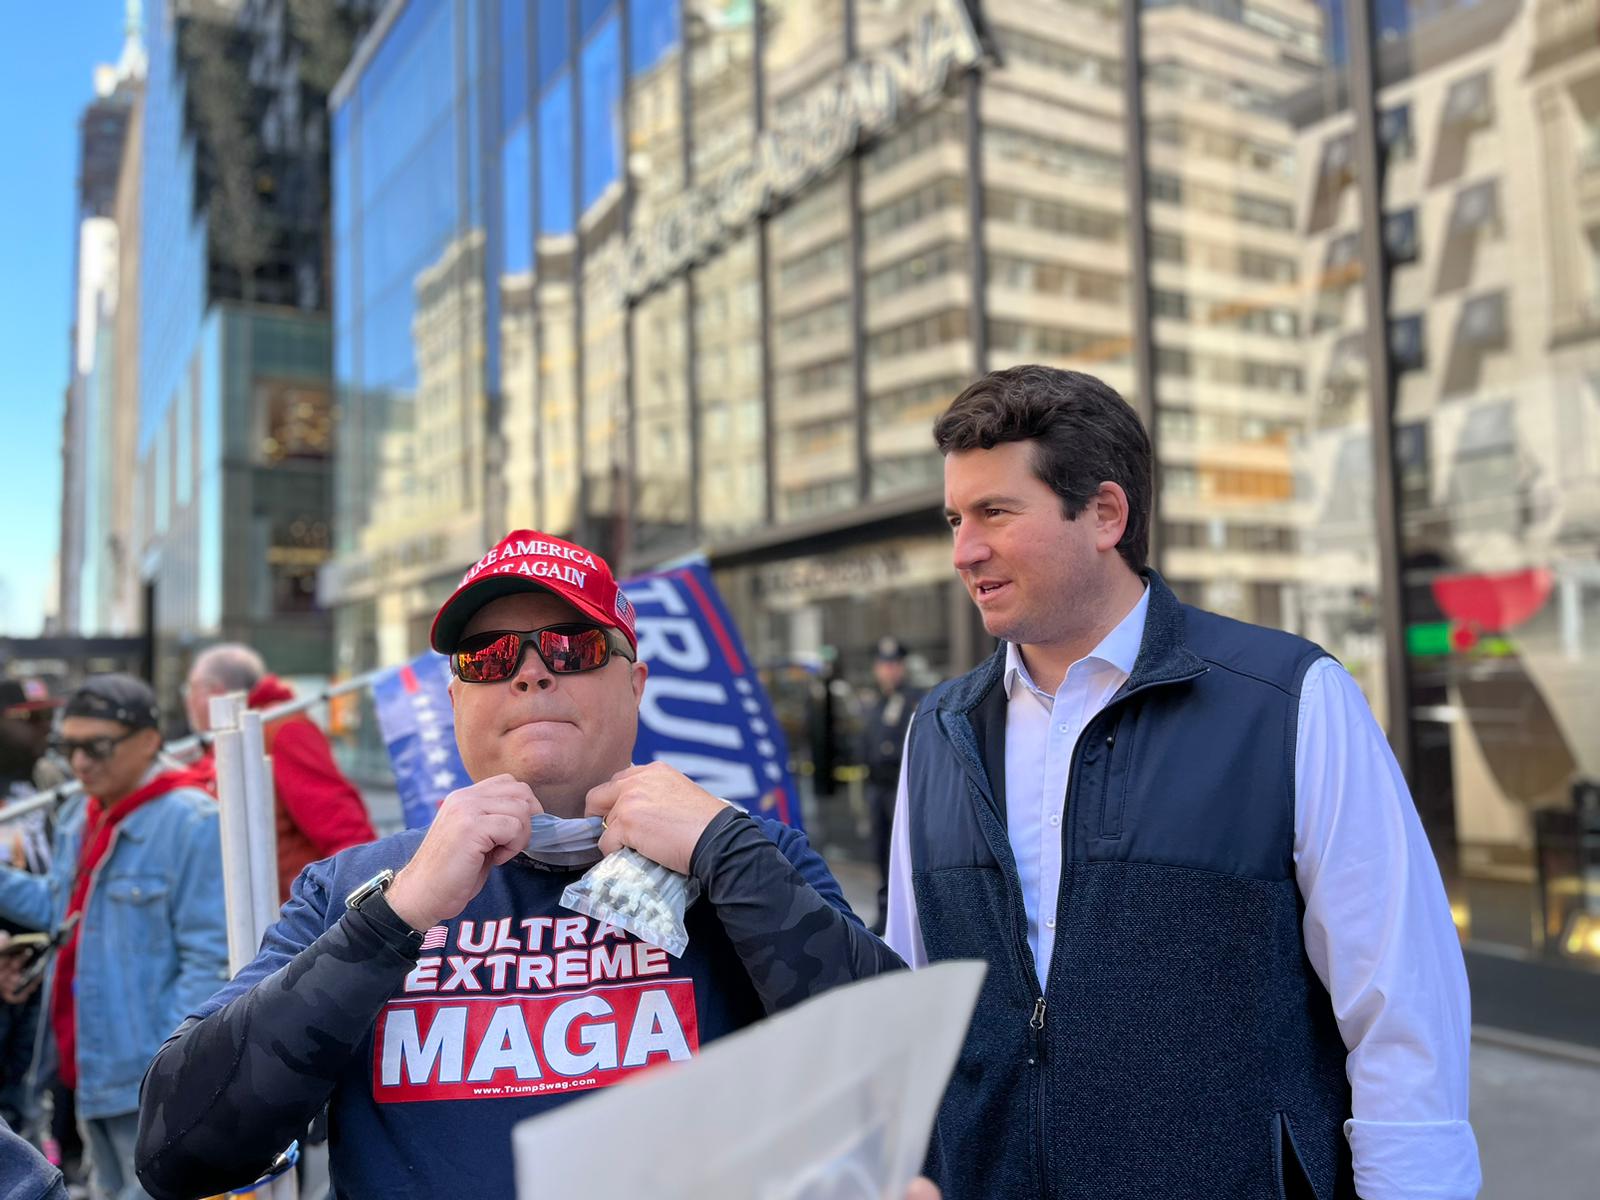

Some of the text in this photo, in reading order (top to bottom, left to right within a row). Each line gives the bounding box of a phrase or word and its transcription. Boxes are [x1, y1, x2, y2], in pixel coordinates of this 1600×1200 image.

[500, 541, 598, 571] AMERICA
[517, 561, 587, 589] AGAIN
[457, 916, 627, 953] ULTRA
[405, 942, 669, 992] EXTREME
[381, 989, 694, 1087] MAGA
[473, 1078, 596, 1094] www.TrumpSwag.com
